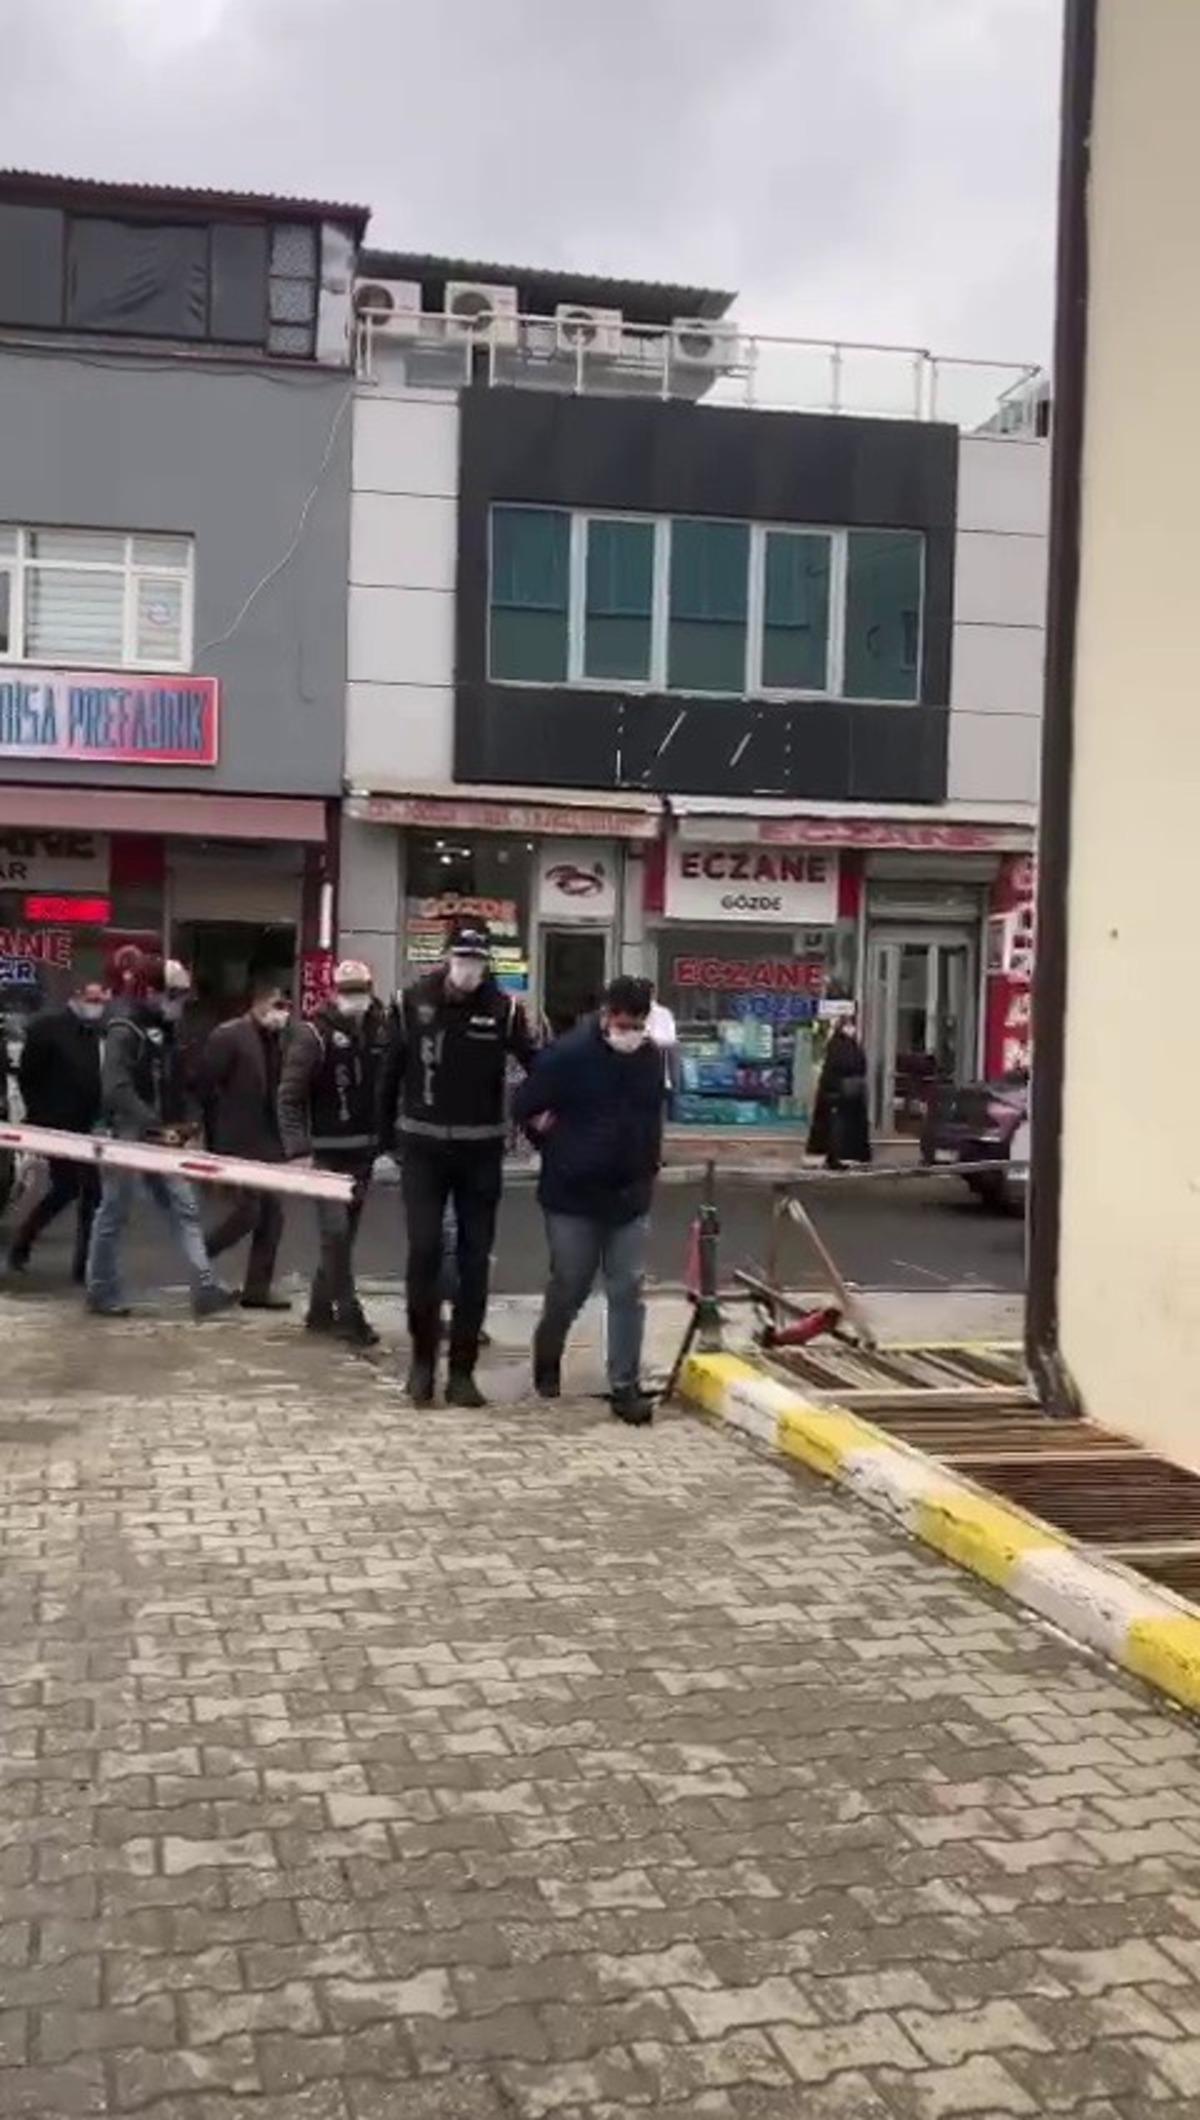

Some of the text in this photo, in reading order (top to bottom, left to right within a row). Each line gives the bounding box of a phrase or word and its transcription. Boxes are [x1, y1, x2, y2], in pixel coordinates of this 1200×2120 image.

[681, 852, 827, 883] ECZANE
[720, 891, 782, 911] GÖZDE
[675, 957, 827, 991] ECZANE
